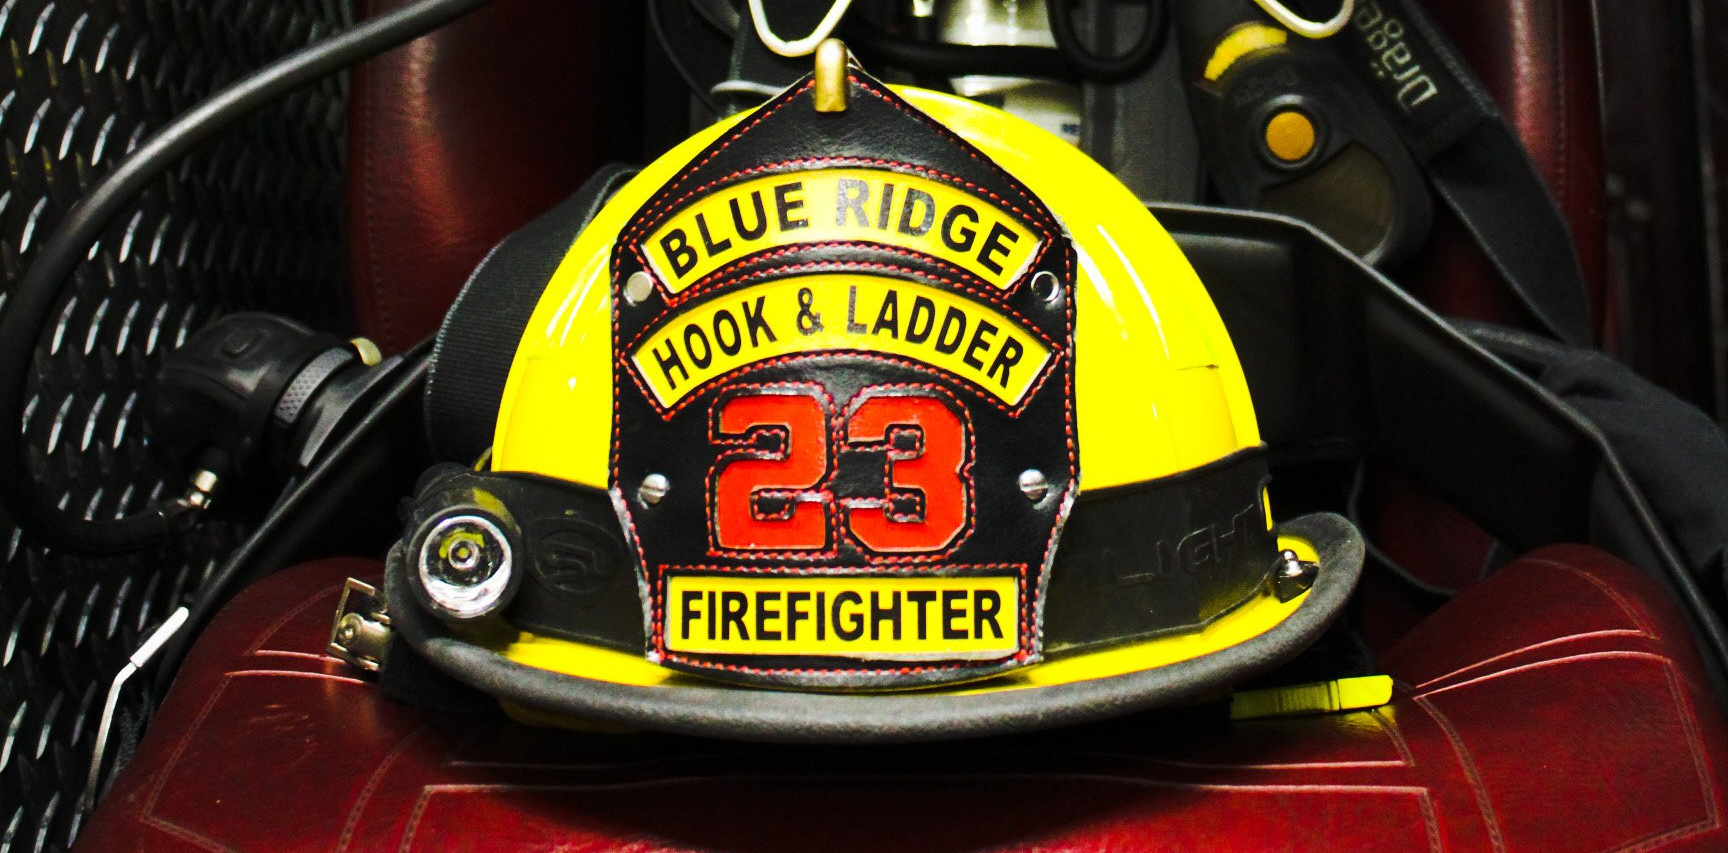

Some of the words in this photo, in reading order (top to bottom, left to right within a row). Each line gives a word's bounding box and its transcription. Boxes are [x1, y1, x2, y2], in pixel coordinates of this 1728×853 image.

[1354, 1, 1438, 114] Dräge
[660, 182, 809, 279] BLUE
[835, 178, 1020, 275] RIDGE
[652, 295, 777, 390] HOOK
[796, 287, 824, 337] &
[846, 285, 1024, 389] LADDER
[715, 394, 967, 552] 23
[681, 590, 1004, 642] FIREFIGHTER
